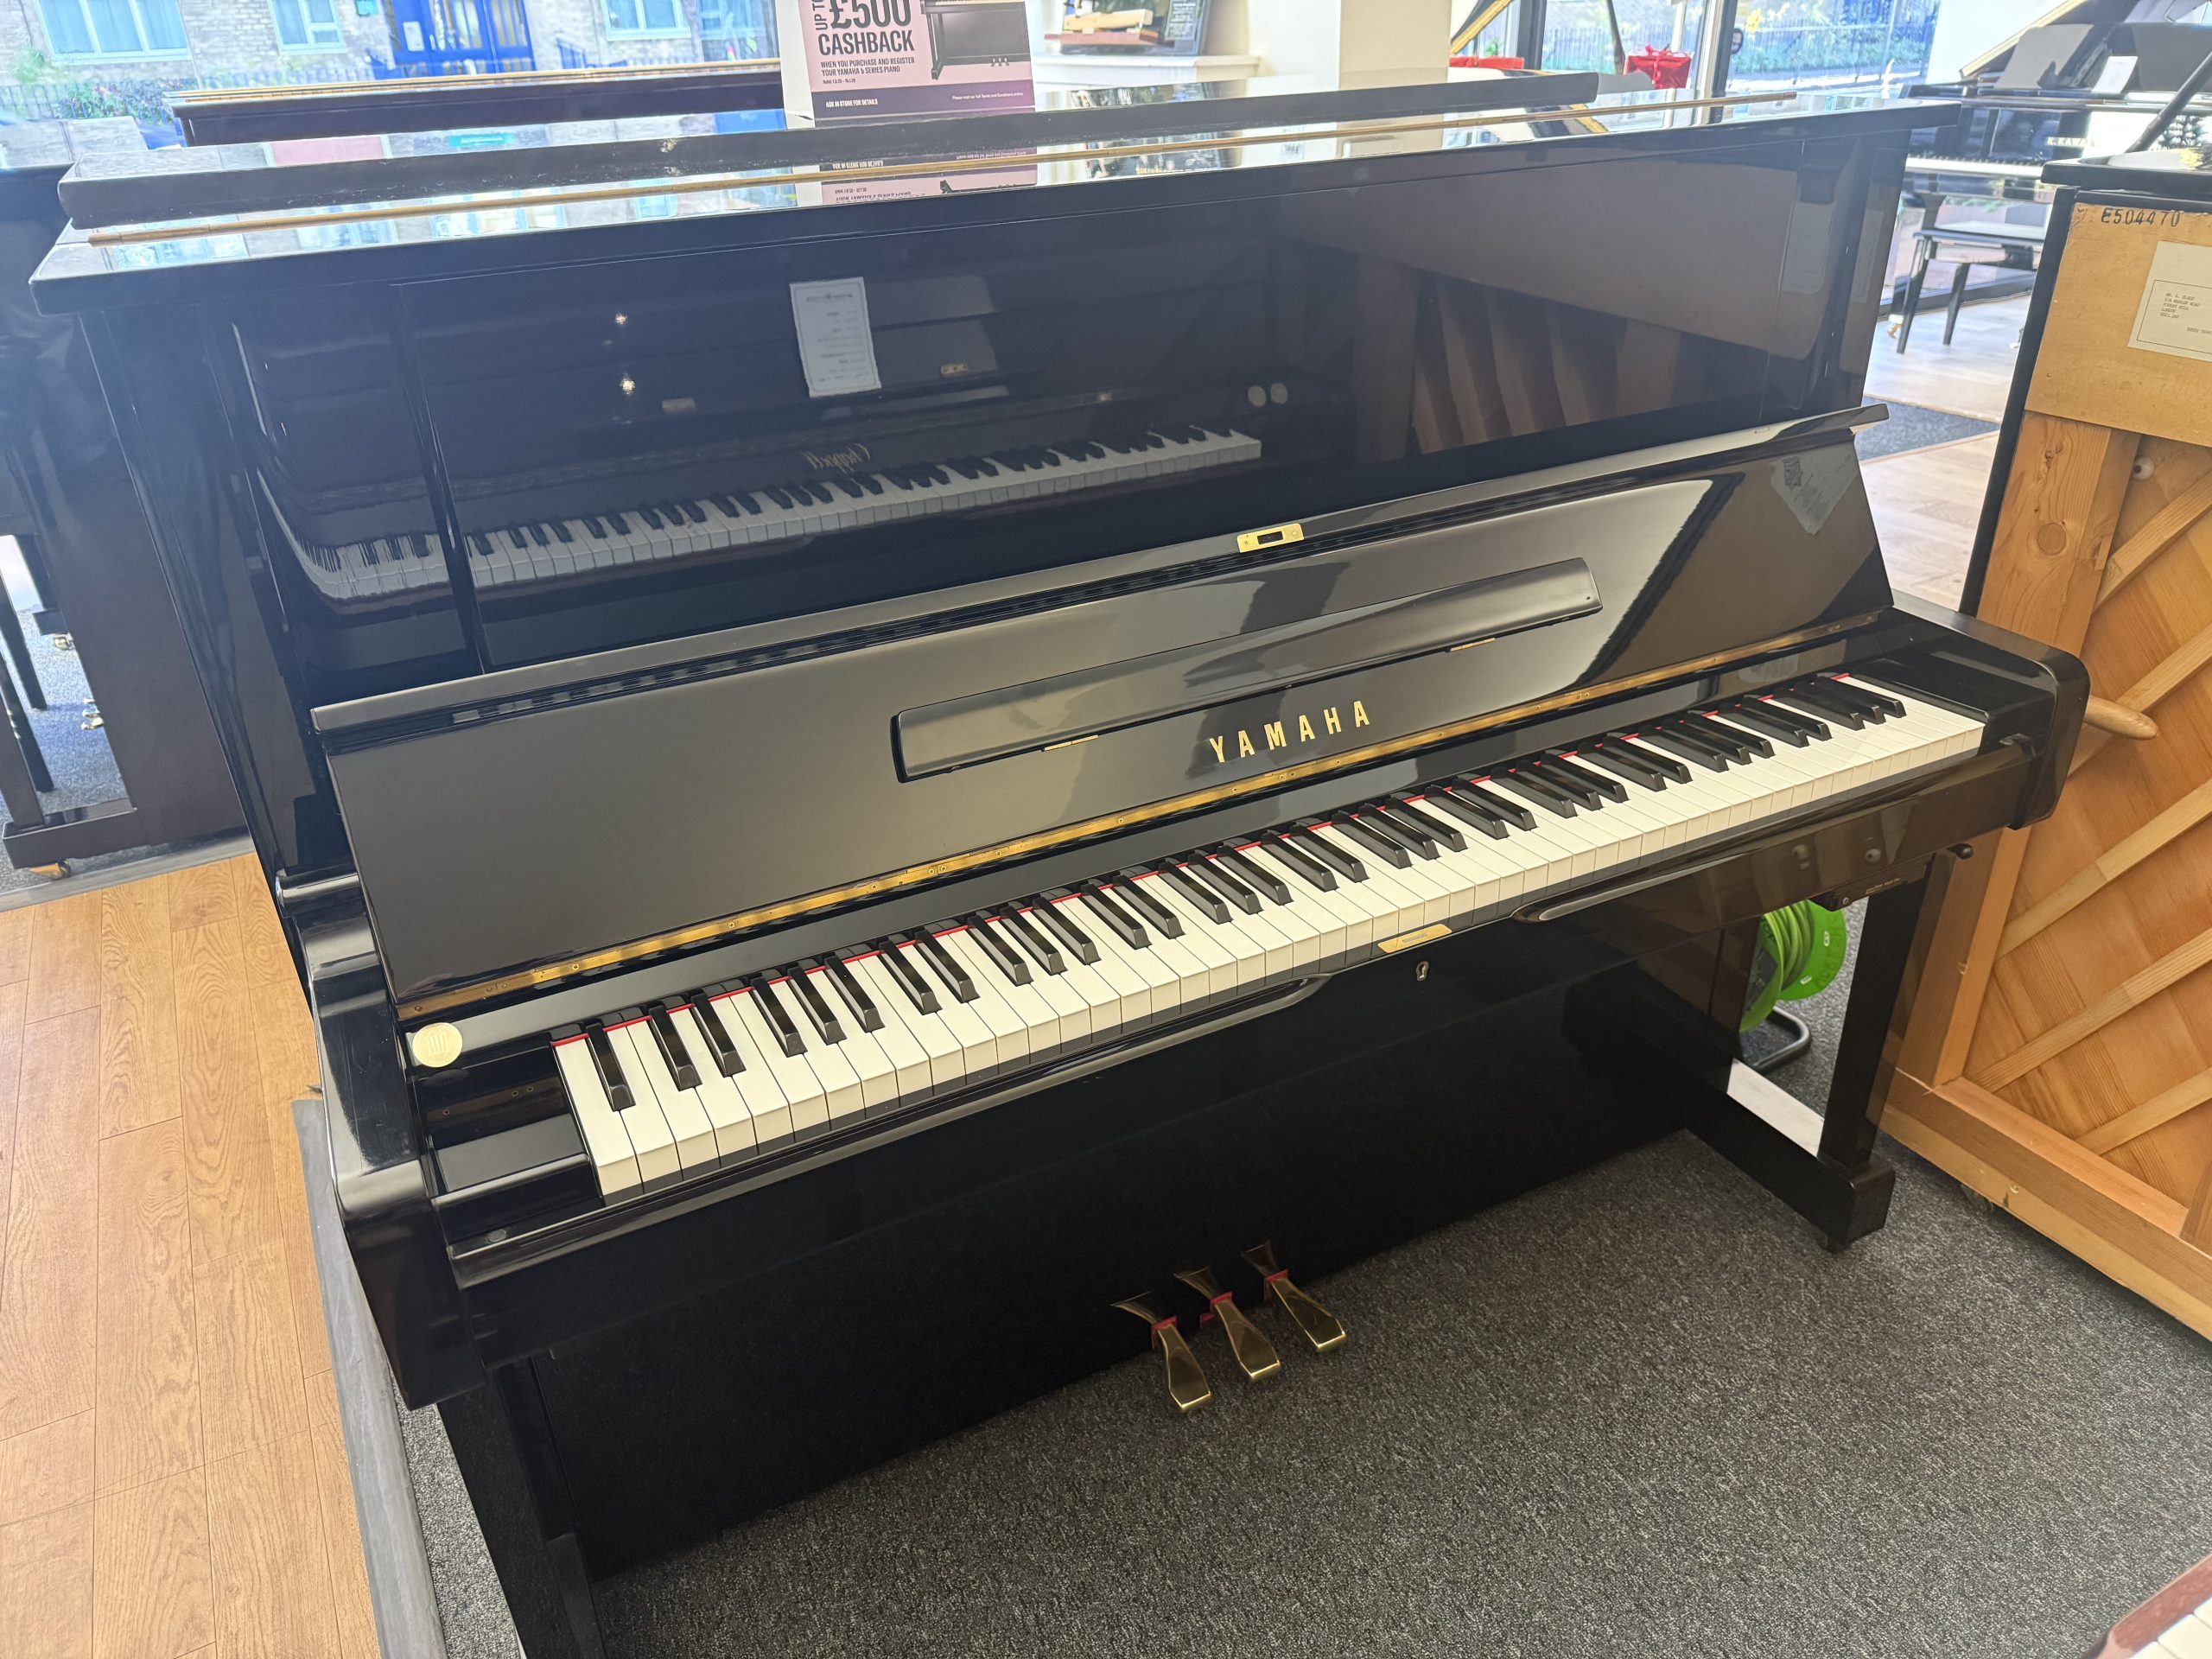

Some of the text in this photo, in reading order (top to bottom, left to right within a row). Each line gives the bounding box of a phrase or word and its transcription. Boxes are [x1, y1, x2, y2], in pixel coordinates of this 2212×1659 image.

[811, 0, 829, 30] UP T
[830, 0, 912, 29] £500
[817, 30, 915, 55] CASHBACK
[890, 56, 915, 65] REGISTER
[2101, 207, 2181, 226] E504470
[1210, 701, 1370, 763] YAMAHA
